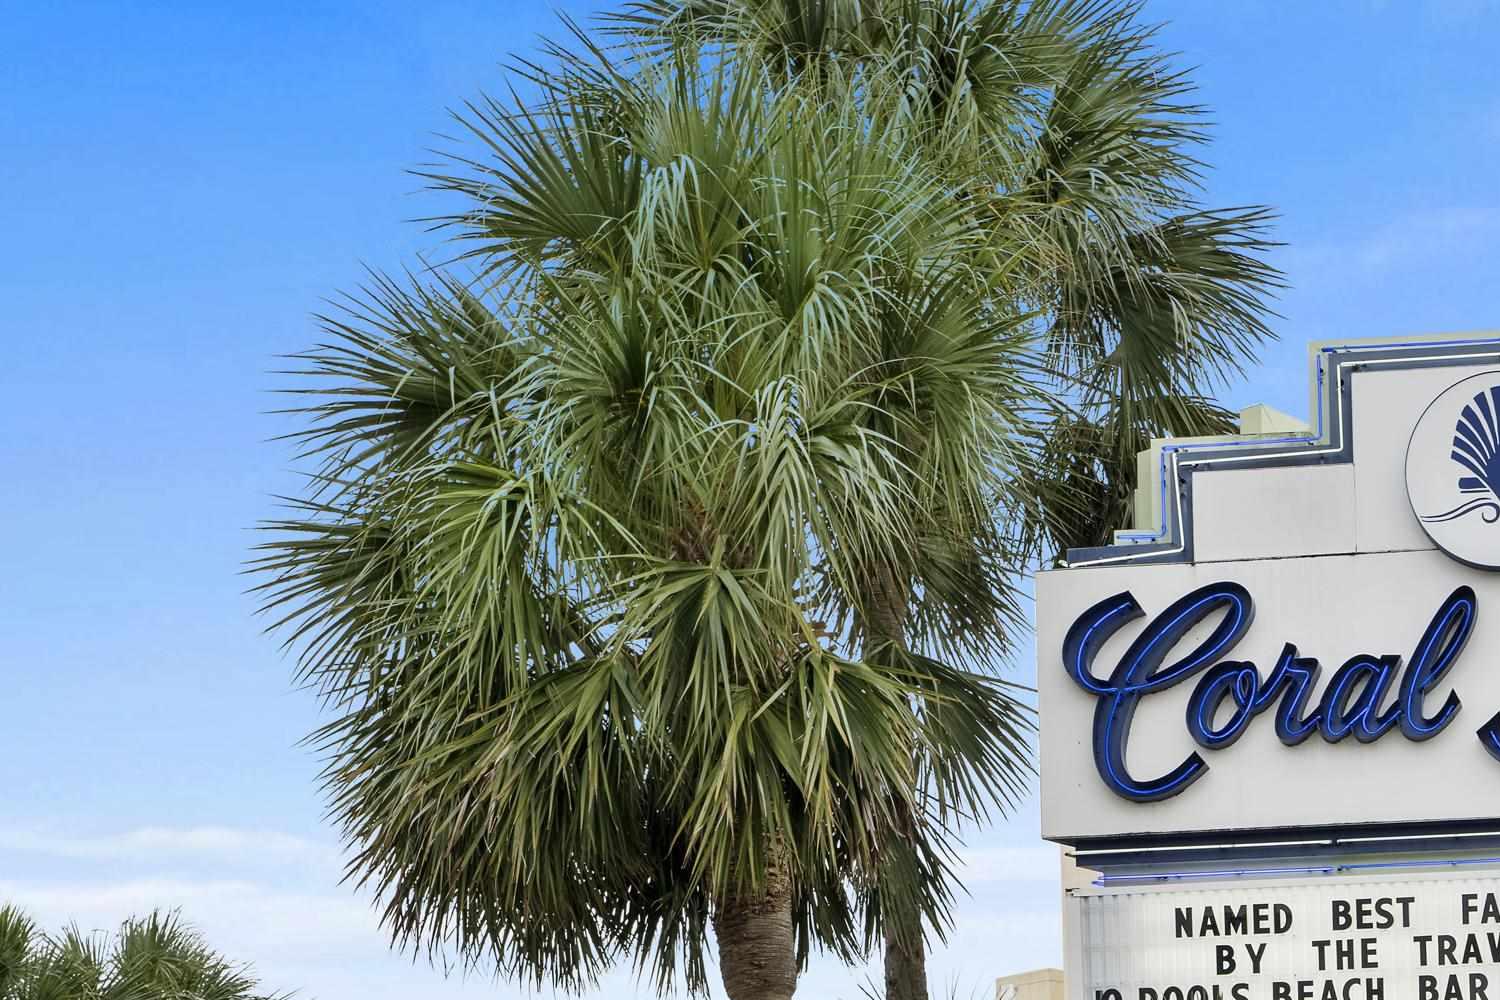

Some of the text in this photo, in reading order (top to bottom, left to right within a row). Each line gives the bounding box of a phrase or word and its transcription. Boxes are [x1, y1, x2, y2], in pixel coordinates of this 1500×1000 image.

[1062, 581, 1478, 803] Coral
[1174, 903, 1293, 938] NAMED
[1331, 896, 1415, 931] BEST
[1215, 943, 1268, 975] BY
[1311, 937, 1379, 971] THE
